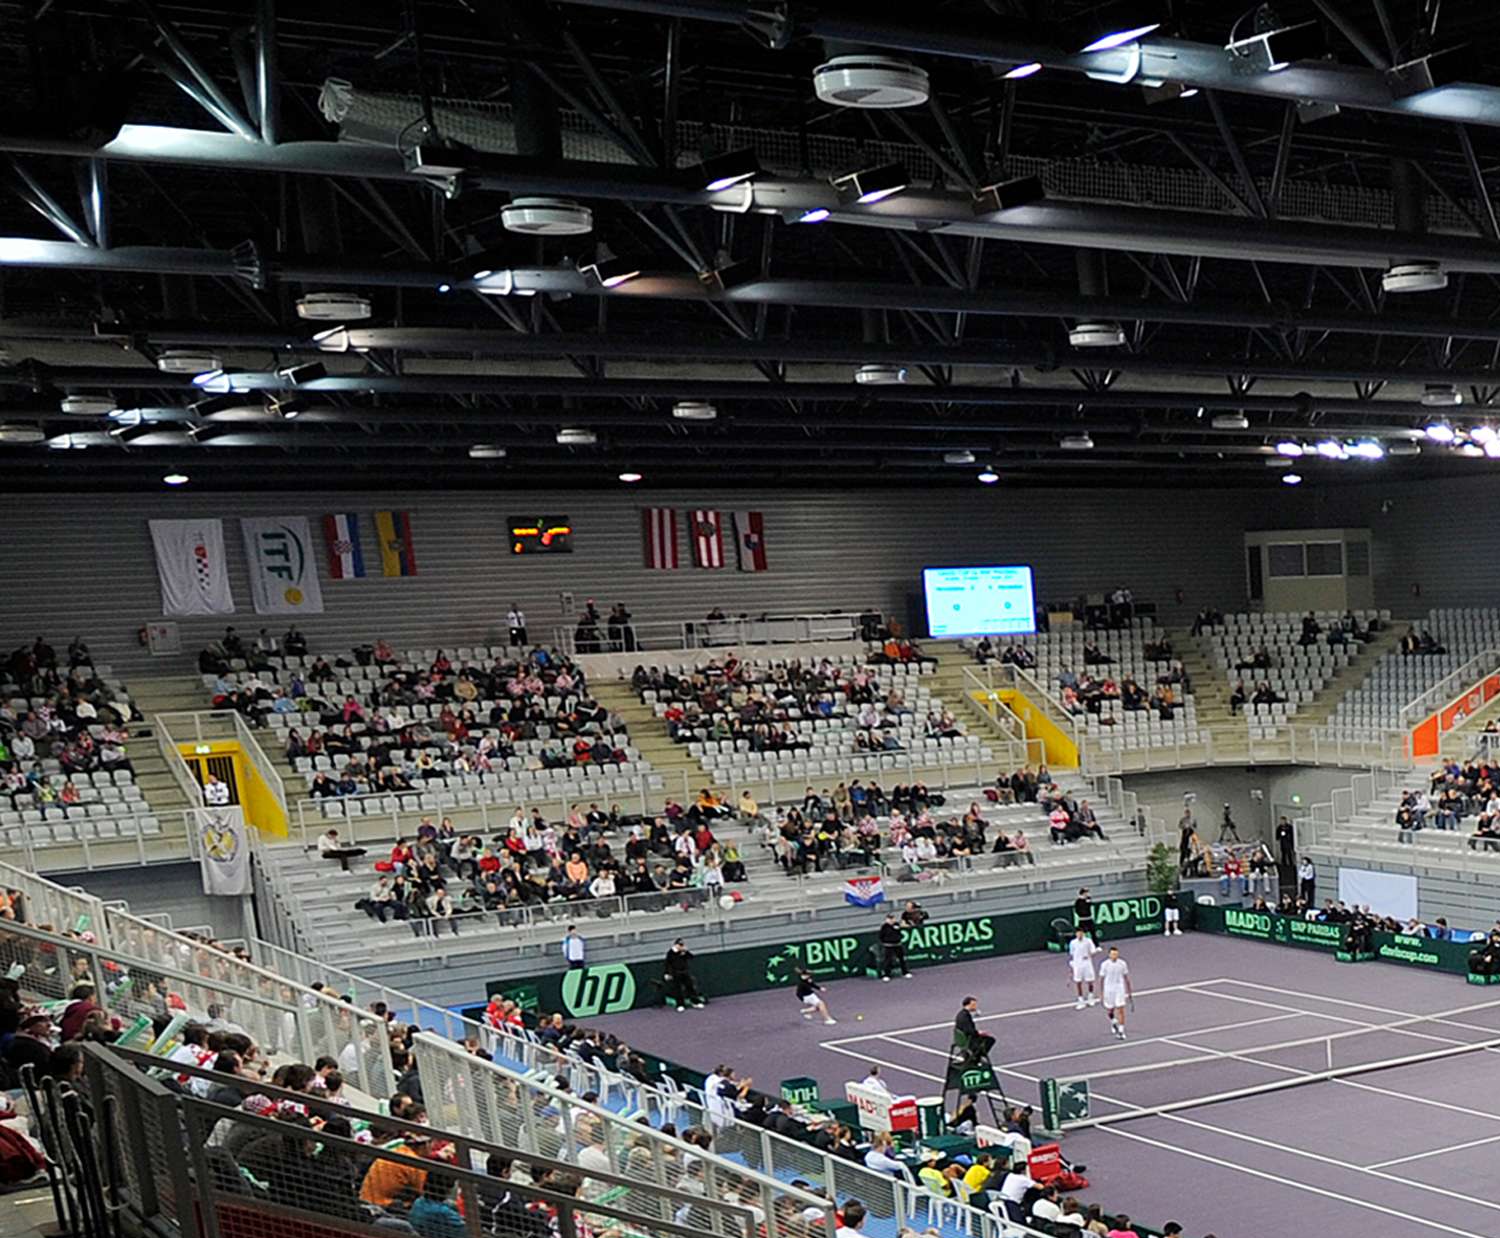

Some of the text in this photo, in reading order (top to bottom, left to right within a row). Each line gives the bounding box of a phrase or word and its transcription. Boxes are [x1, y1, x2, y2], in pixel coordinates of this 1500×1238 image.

[262, 532, 294, 582] ITF
[1225, 910, 1271, 932] MADRID
[806, 938, 858, 964] BNP
[574, 967, 627, 1014] hp
